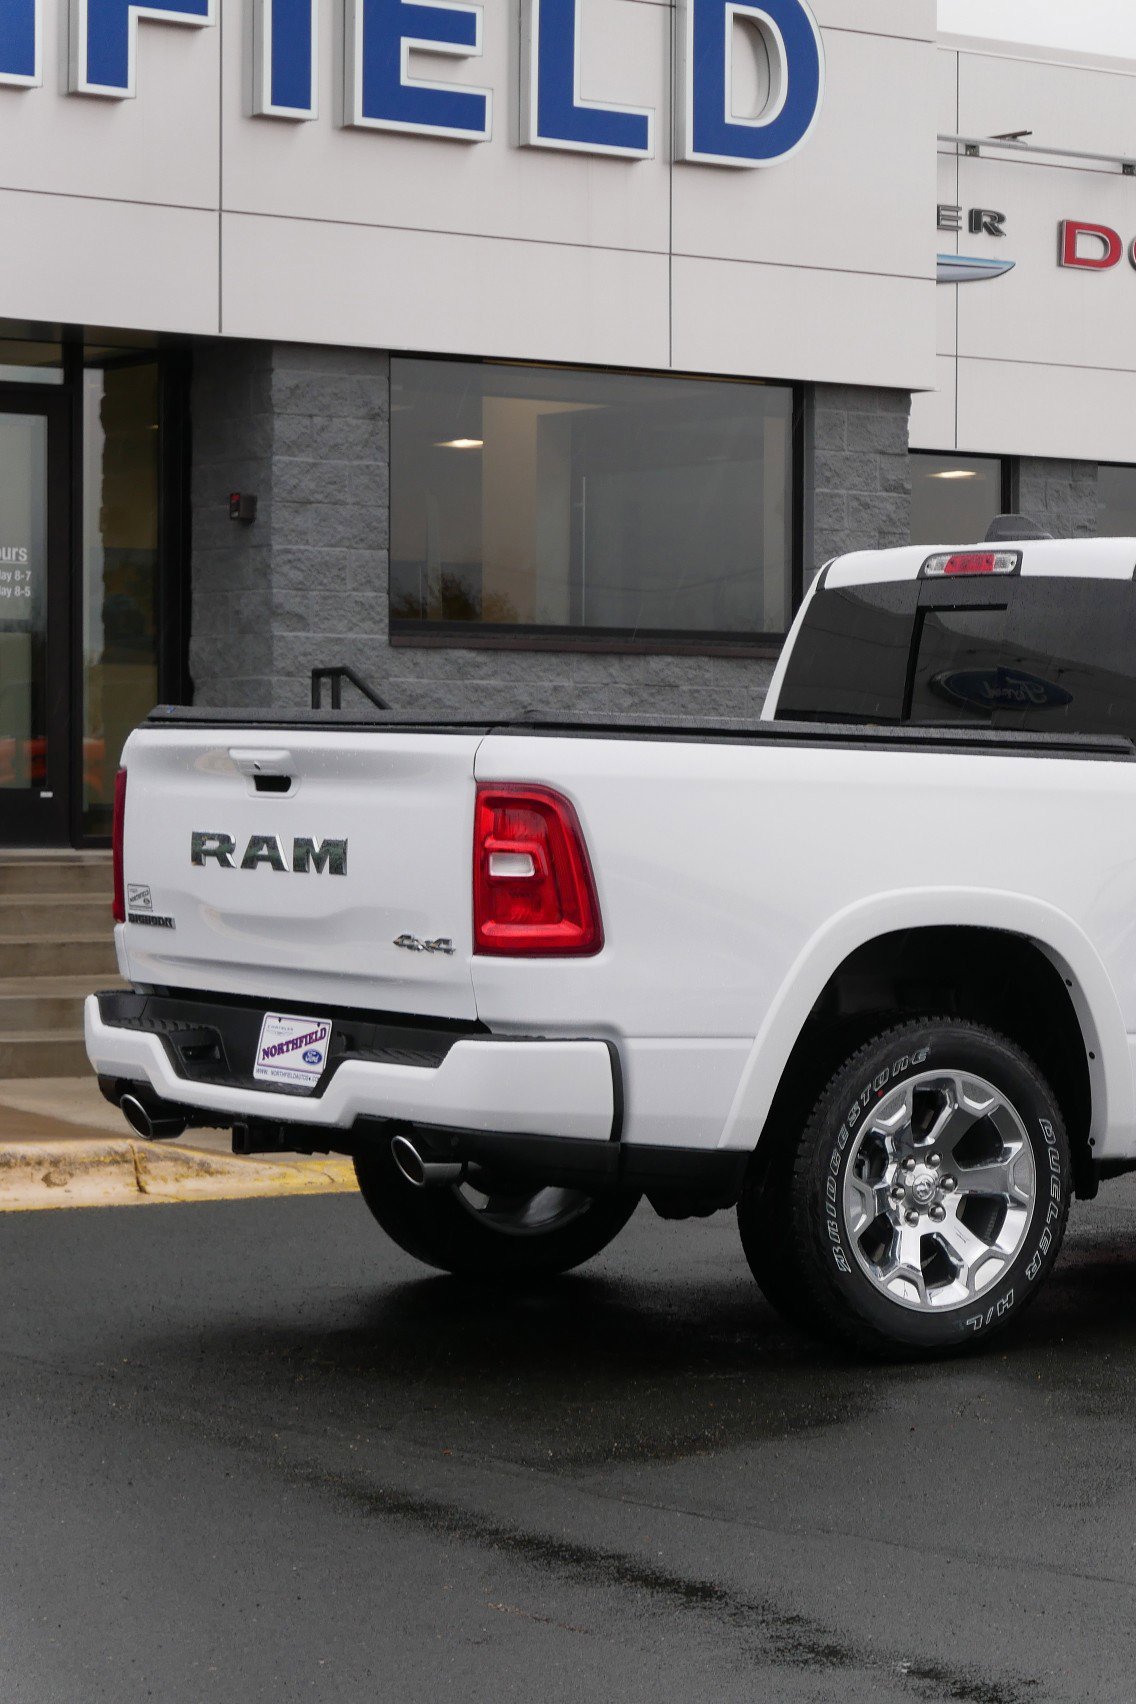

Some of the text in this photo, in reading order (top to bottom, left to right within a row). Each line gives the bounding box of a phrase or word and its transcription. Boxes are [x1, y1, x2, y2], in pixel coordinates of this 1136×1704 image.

[0, 546, 28, 561] urs
[191, 831, 349, 876] RAM
[261, 1027, 327, 1061] NORTHFIELD
[826, 1048, 932, 1274] BRIDGESTONE
[966, 1118, 1062, 1331] DUELER H/L
